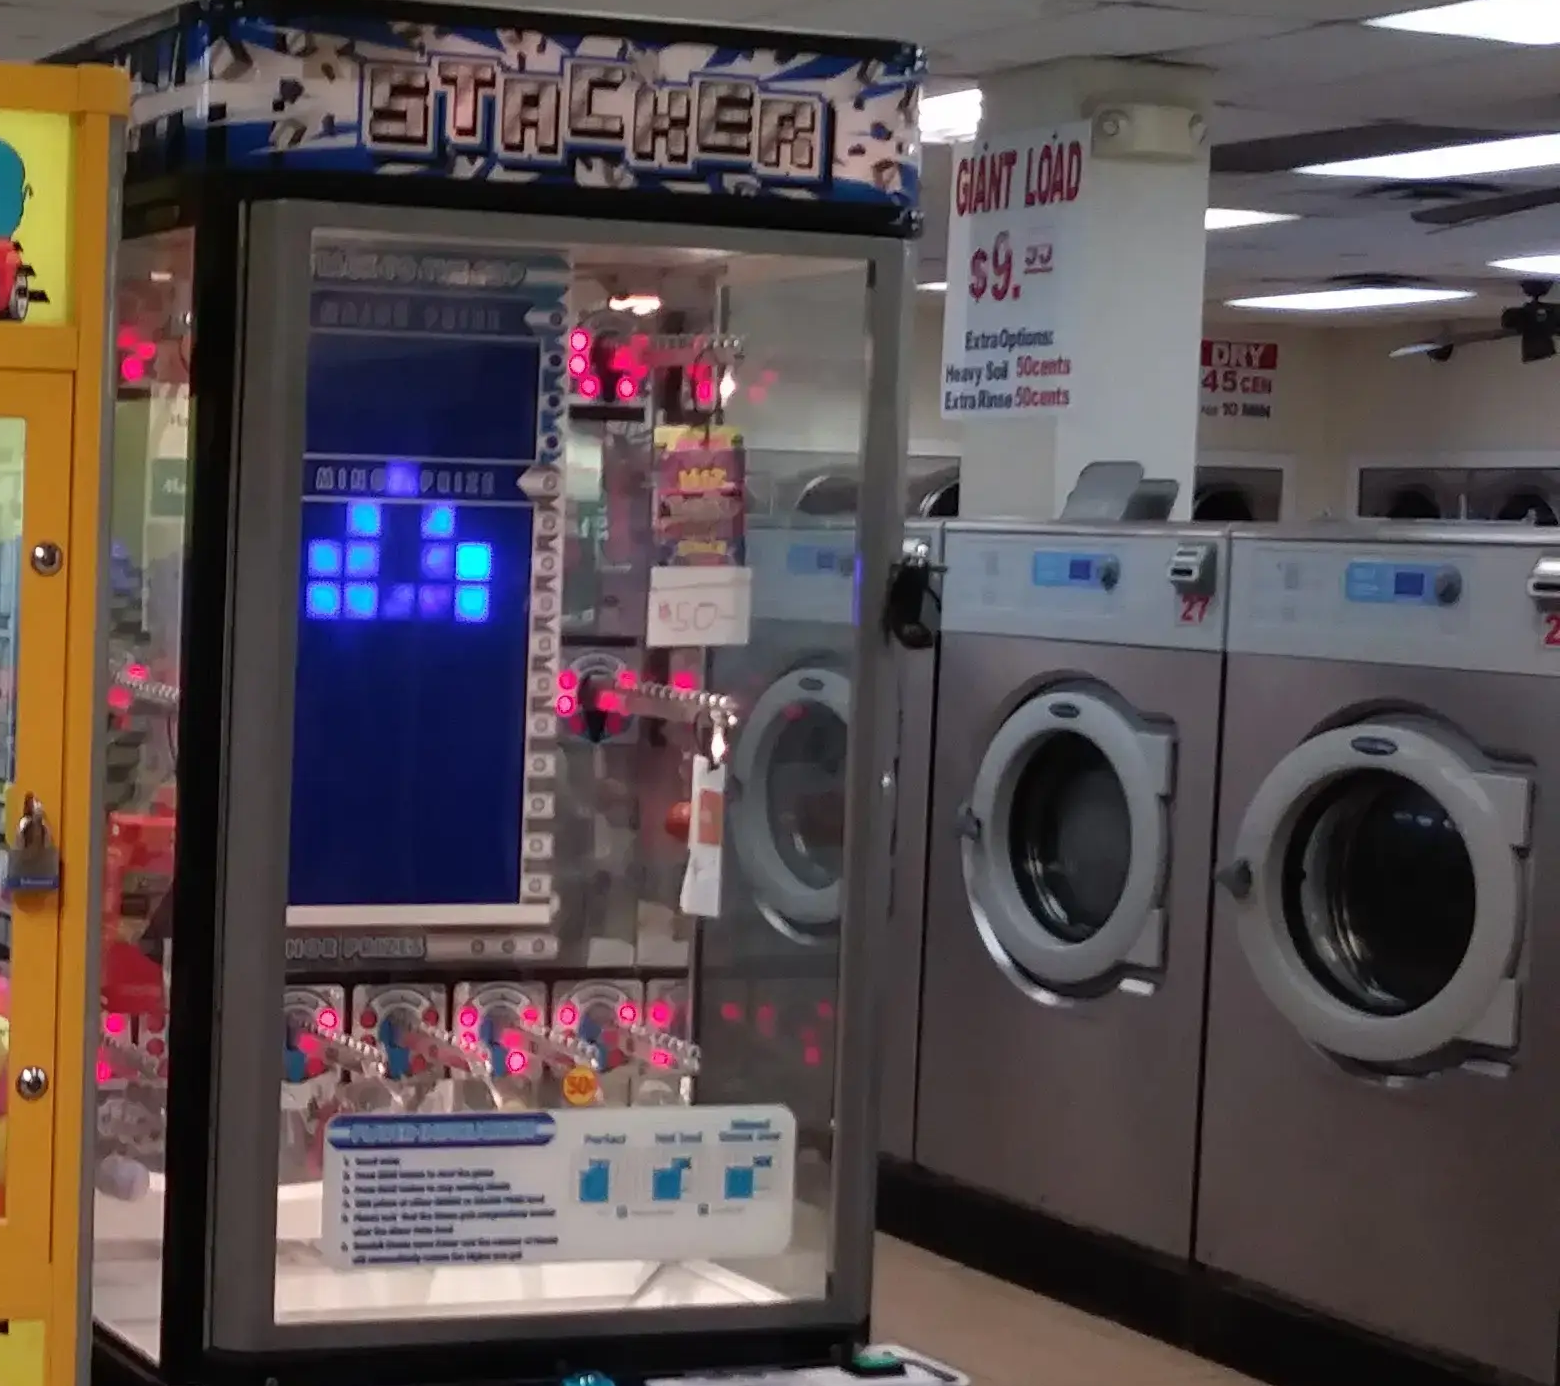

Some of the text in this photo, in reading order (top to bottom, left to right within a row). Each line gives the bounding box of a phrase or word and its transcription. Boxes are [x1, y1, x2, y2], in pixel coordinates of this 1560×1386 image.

[367, 58, 818, 169] STACKER
[956, 140, 1082, 217] GIANT LOAD
[965, 330, 998, 351] Extra
[945, 364, 982, 387] Heavy
[985, 360, 1009, 381] Soil
[945, 390, 976, 410] Extra
[977, 389, 1013, 409] Rinse
[315, 466, 410, 492] MINO
